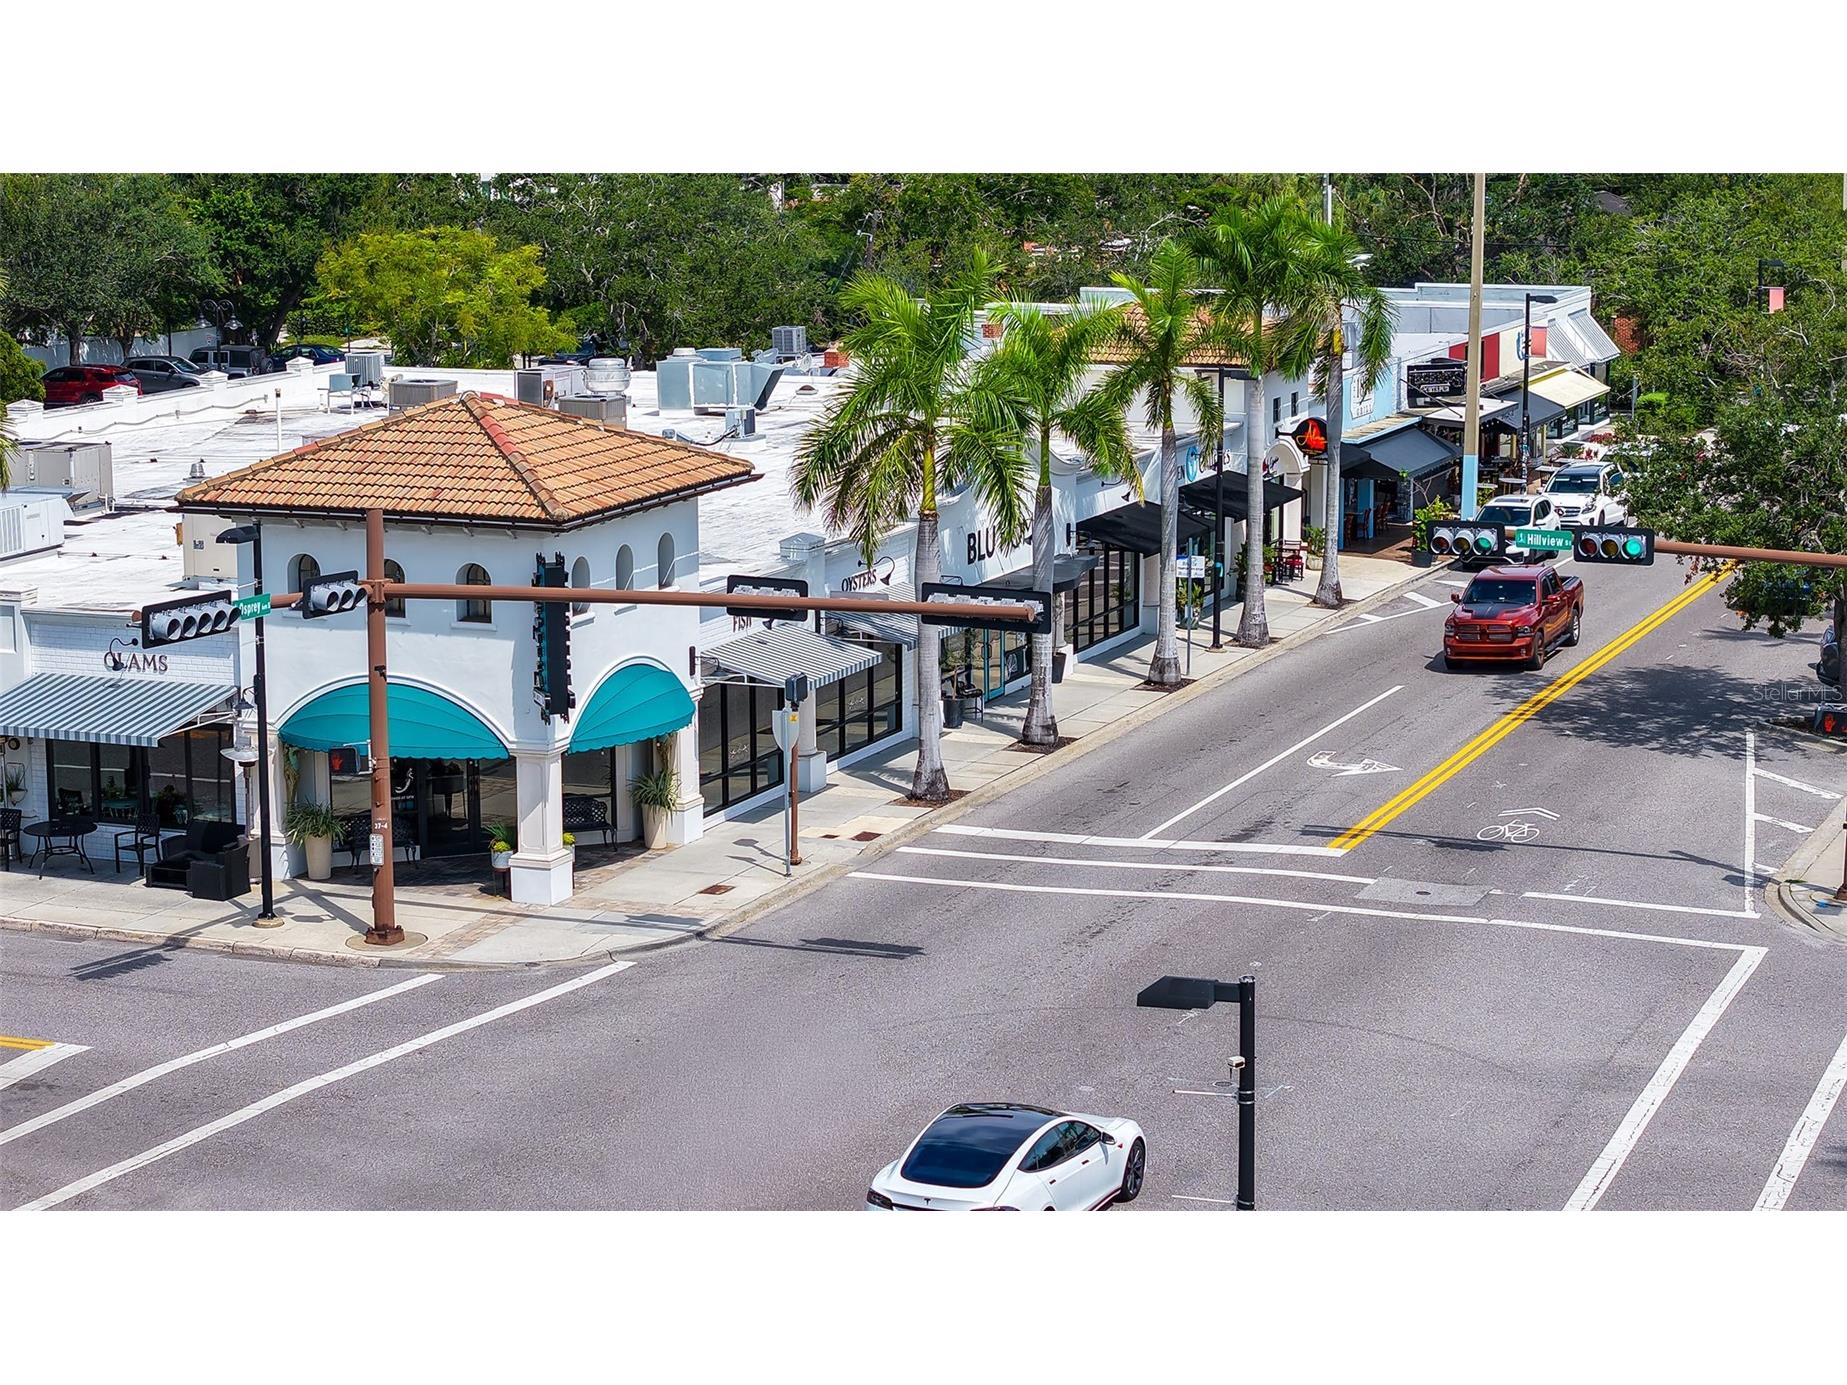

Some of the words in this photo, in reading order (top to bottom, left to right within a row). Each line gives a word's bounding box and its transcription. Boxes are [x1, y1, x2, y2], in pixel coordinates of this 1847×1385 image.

[967, 525, 996, 566] BLU
[1527, 533, 1564, 547] Hillview
[841, 569, 877, 591] OYSTERS
[104, 651, 168, 673] CLAMS
